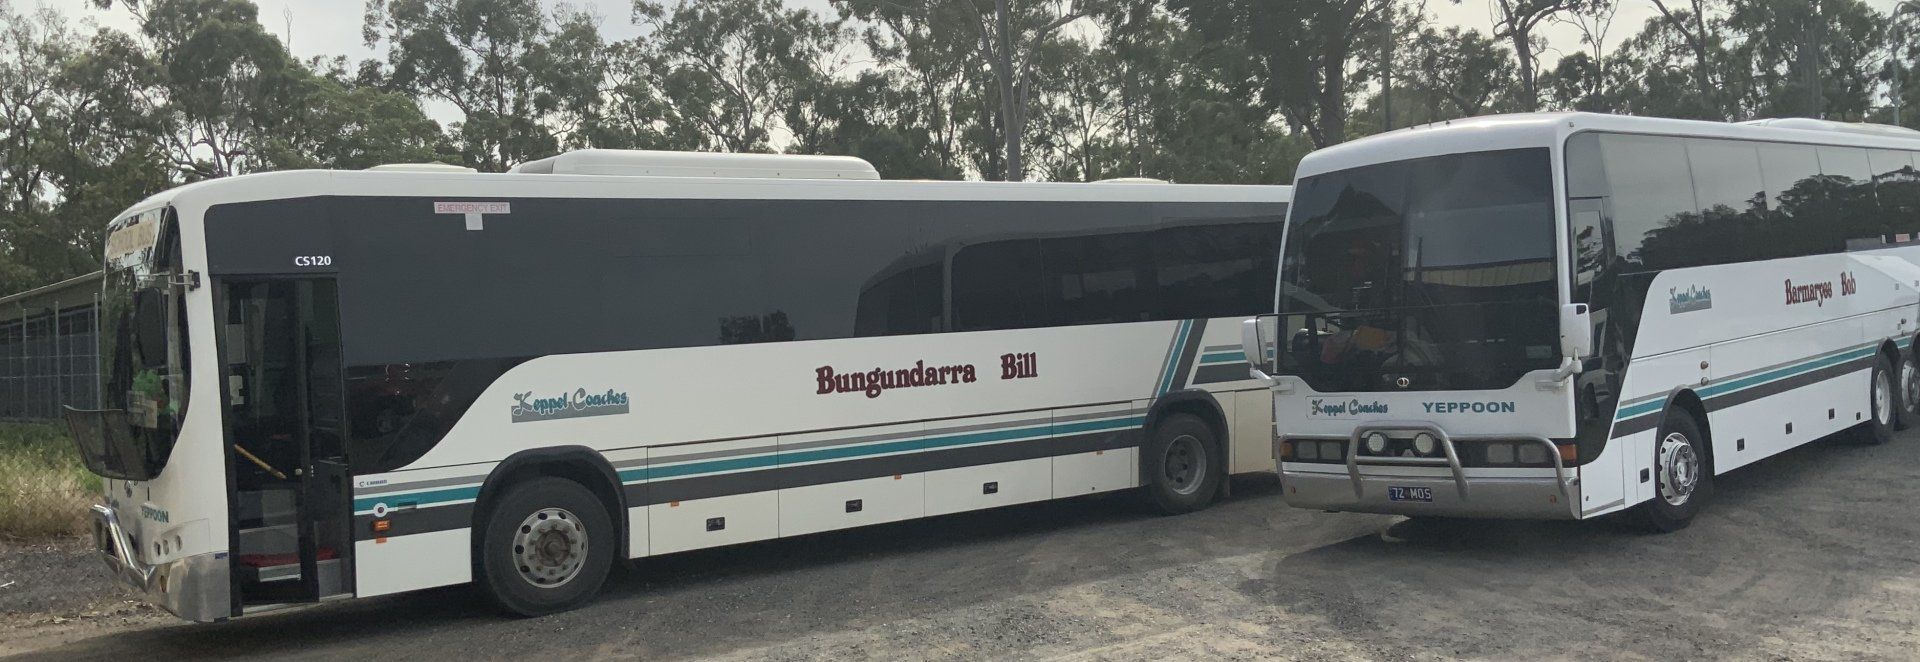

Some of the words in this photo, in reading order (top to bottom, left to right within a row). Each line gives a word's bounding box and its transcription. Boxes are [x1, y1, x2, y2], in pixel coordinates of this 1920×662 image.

[437, 203, 488, 213] EMERGENCY
[490, 203, 508, 213] EXIT
[295, 255, 332, 266] CS120
[1840, 270, 1857, 296] Bob
[815, 359, 977, 399] Bungundarra
[1000, 351, 1038, 380] Bill
[513, 390, 568, 415] Keppel
[572, 387, 628, 411] Coaches
[1311, 398, 1346, 416] Keppel
[1348, 398, 1389, 415] Coaches
[1421, 401, 1515, 414] YEPPOON
[1392, 487, 1405, 499] 72
[1409, 487, 1431, 499] MOS
